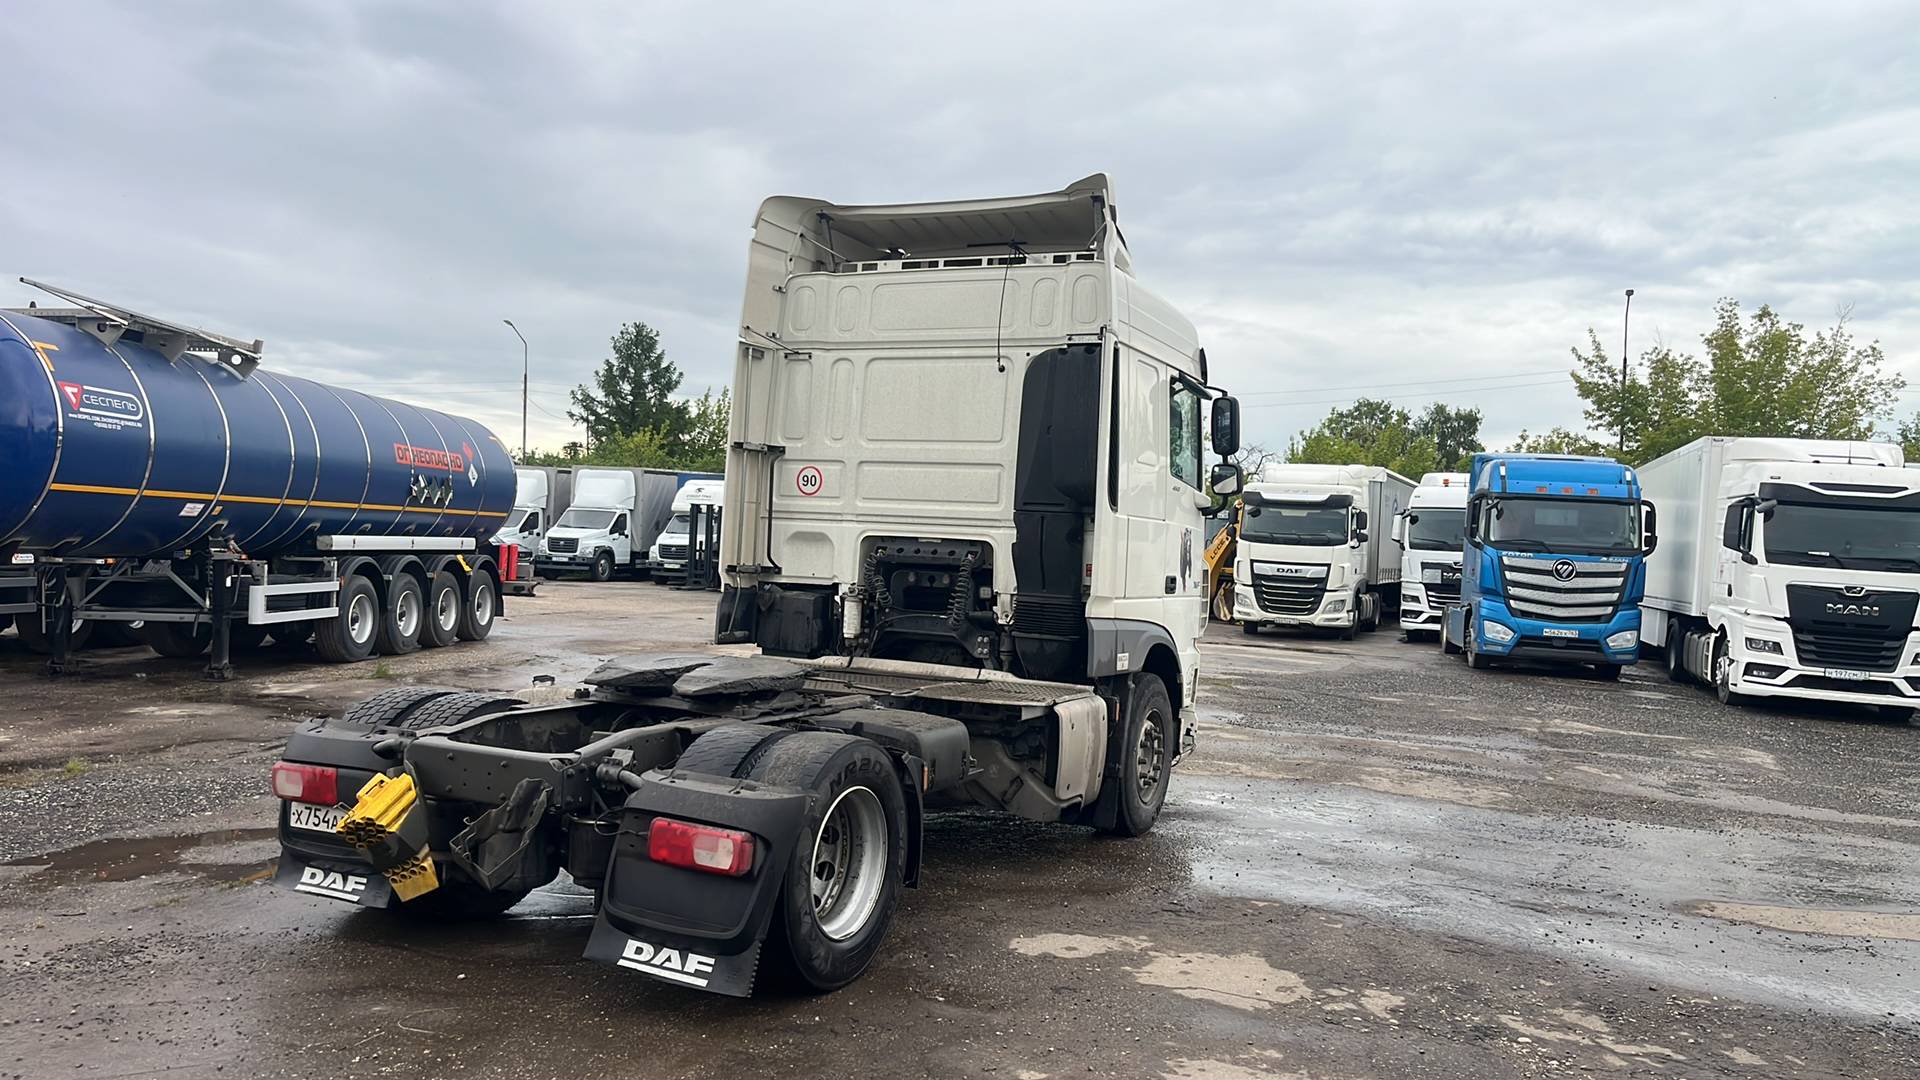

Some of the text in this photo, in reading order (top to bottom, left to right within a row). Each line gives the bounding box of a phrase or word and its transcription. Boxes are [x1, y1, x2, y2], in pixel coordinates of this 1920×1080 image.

[82, 394, 137, 411] СЕСПЕЛЬ
[396, 446, 462, 469] ОГНЕОПАСНО
[802, 474, 817, 487] 90
[1443, 572, 1462, 580] MA
[1826, 603, 1880, 616] MAN
[295, 806, 344, 831] Х754А
[300, 866, 368, 892] DAF
[622, 939, 716, 974] DAF
